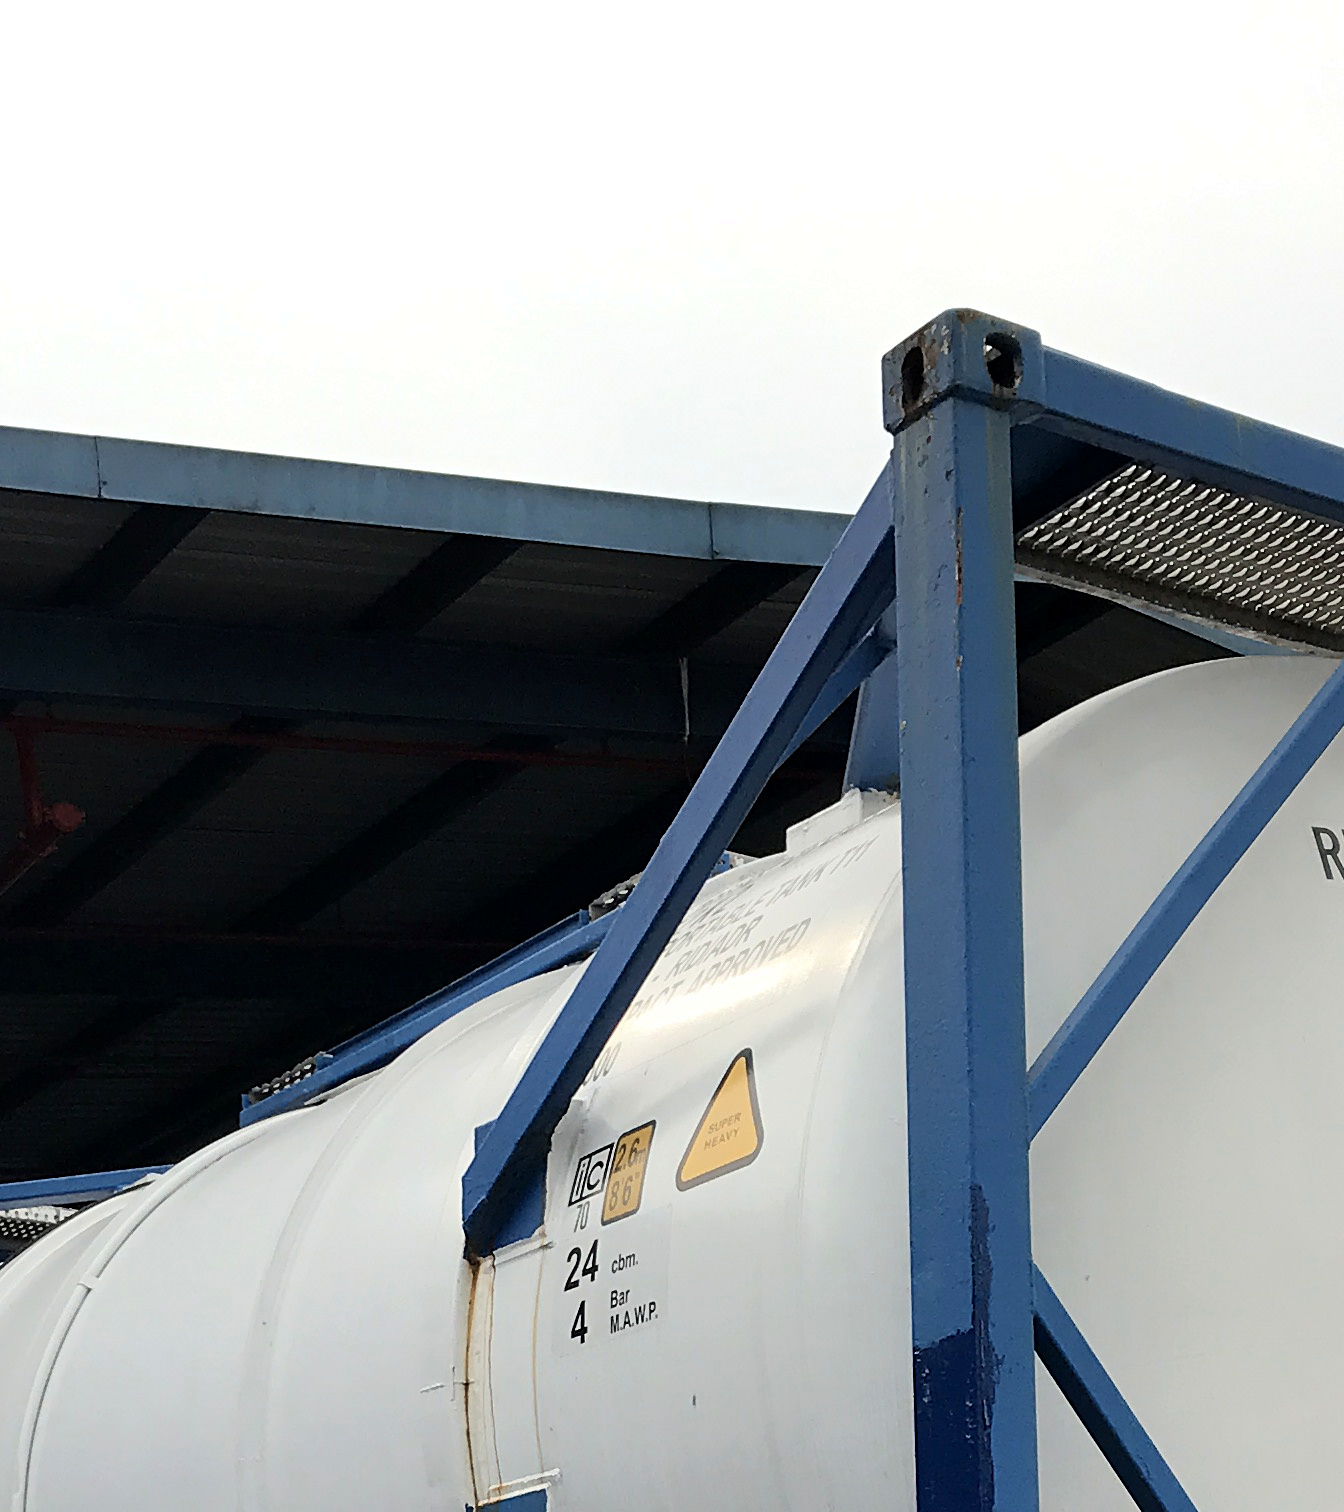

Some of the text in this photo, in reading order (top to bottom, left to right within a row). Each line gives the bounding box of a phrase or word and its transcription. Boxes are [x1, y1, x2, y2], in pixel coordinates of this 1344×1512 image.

[703, 1127, 740, 1150] HEAVY
[707, 1112, 742, 1135] SUPER
[573, 1200, 591, 1233] 70
[563, 1238, 640, 1293] 24 cbm.
[570, 1288, 631, 1345] 4 Bar
[609, 1300, 659, 1335] M.A.W.P.
